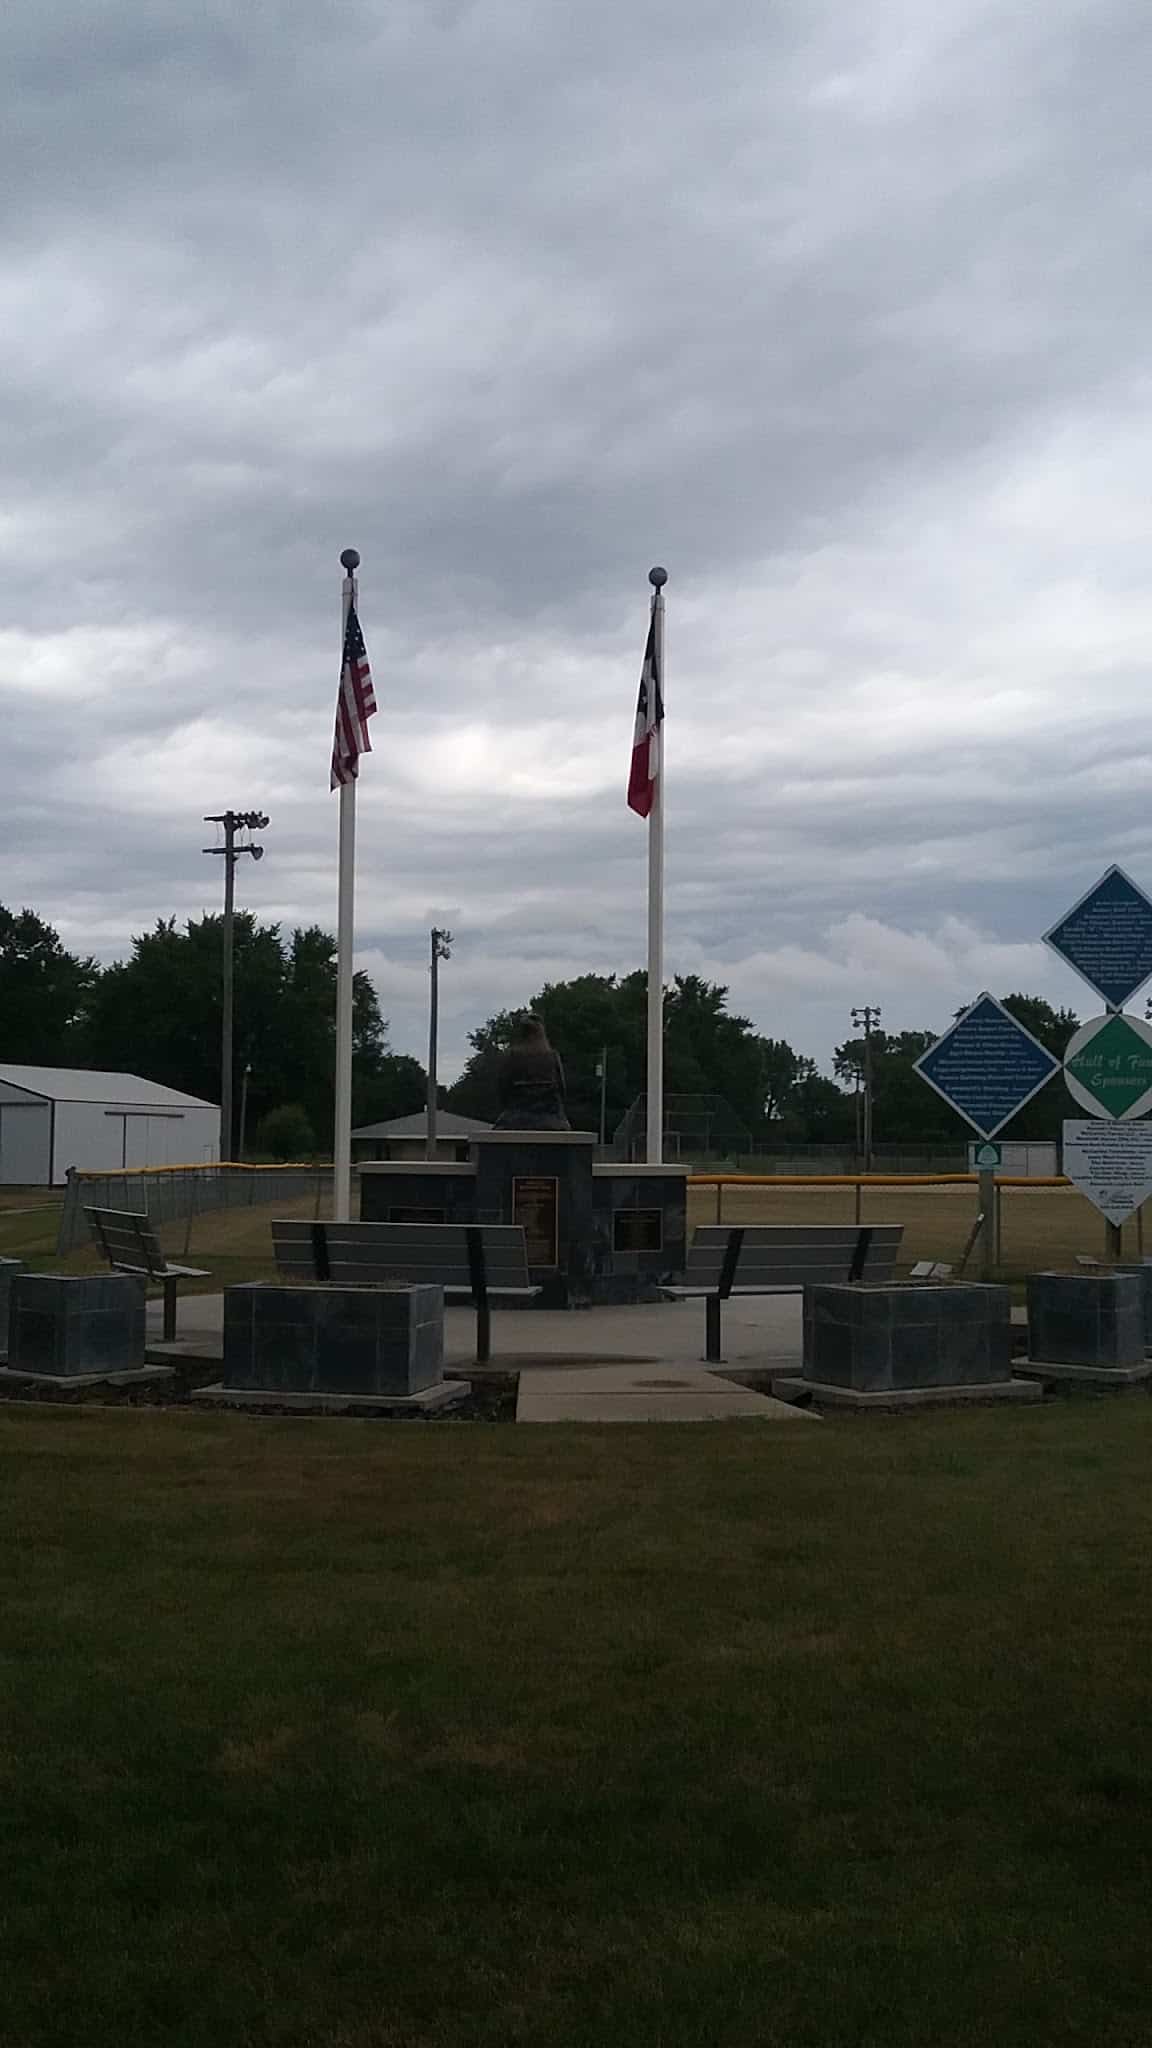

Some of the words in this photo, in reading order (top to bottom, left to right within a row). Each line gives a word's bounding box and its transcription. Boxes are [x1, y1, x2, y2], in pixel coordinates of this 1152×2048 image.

[1071, 1055, 1103, 1068] Hall
[1107, 1055, 1121, 1071] of
[1089, 1071, 1147, 1089] Sponsors
